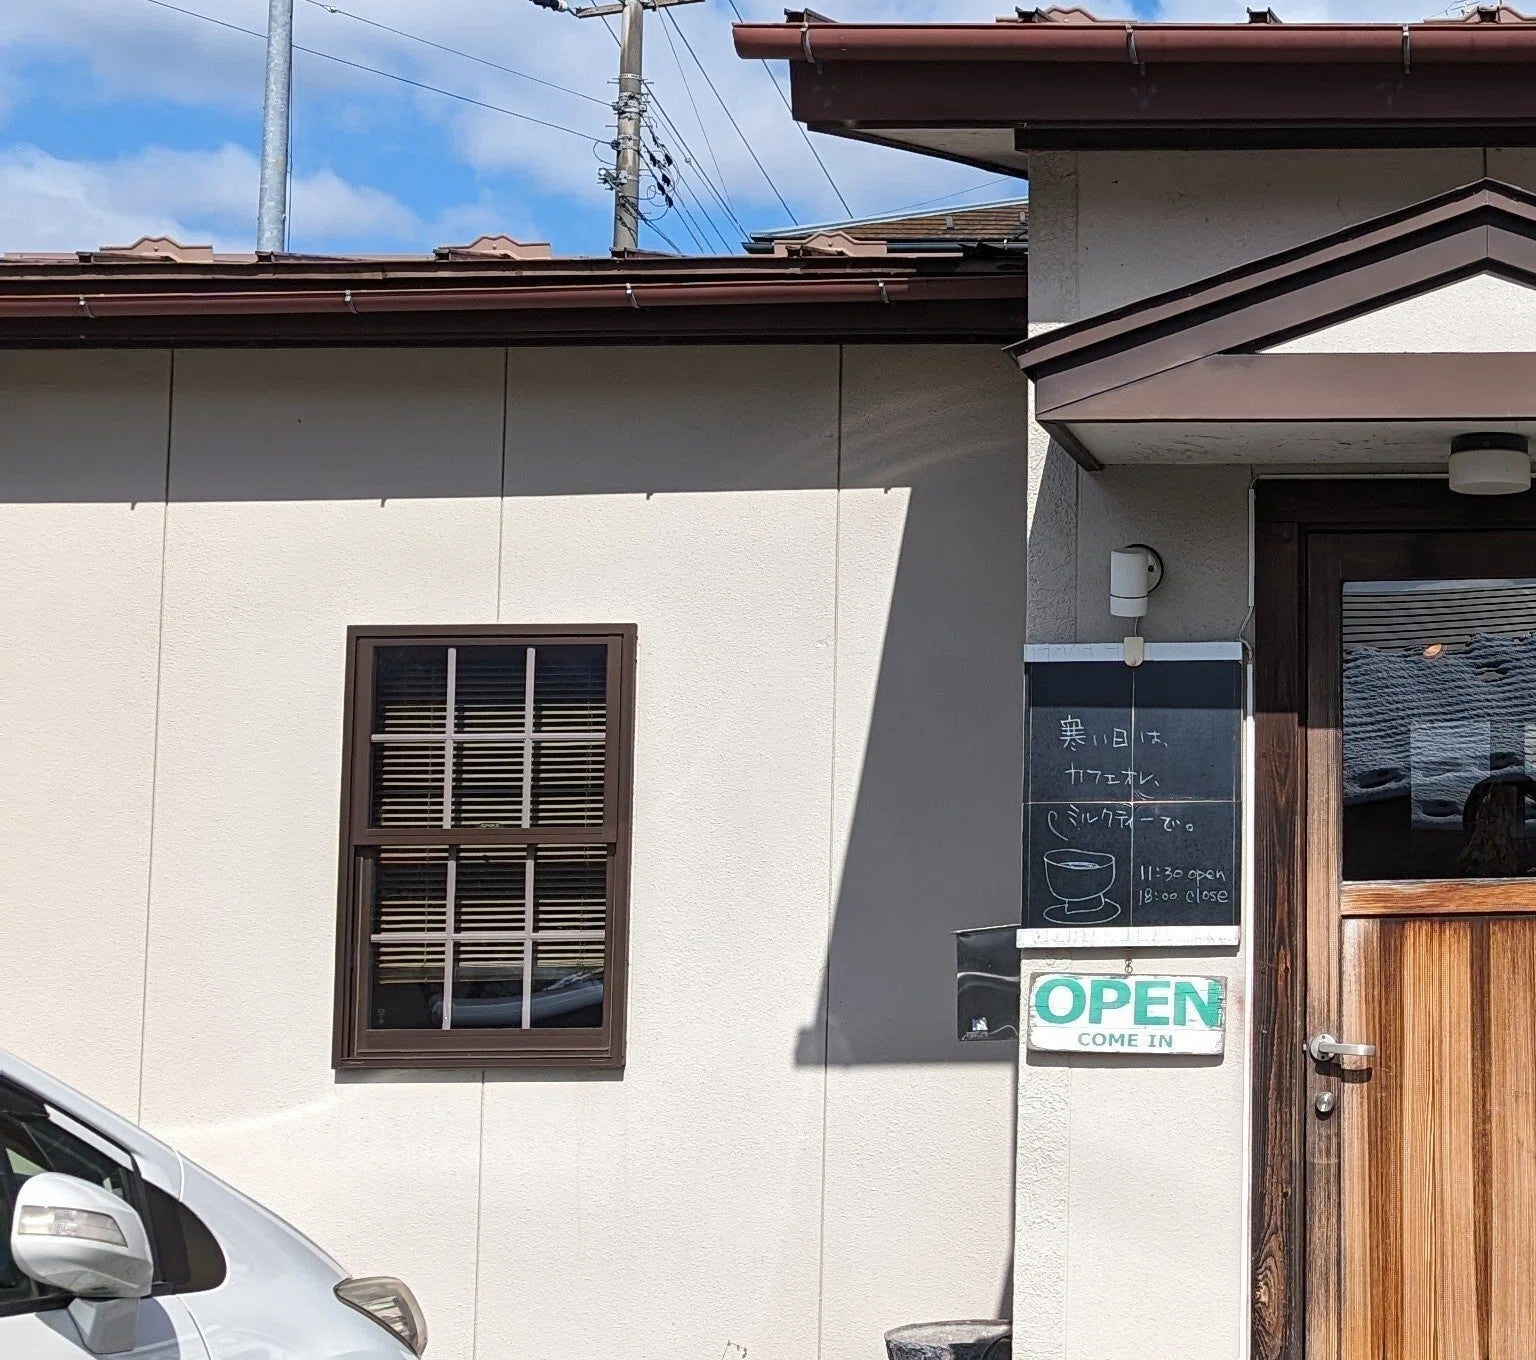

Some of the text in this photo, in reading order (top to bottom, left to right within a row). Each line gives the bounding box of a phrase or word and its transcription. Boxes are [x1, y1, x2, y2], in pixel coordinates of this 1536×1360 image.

[1140, 864, 1226, 886] 11:30 open
[1138, 889, 1229, 906] 18:00 close
[1034, 978, 1223, 1027] OPEN
[1077, 1032, 1173, 1048] COME IN
